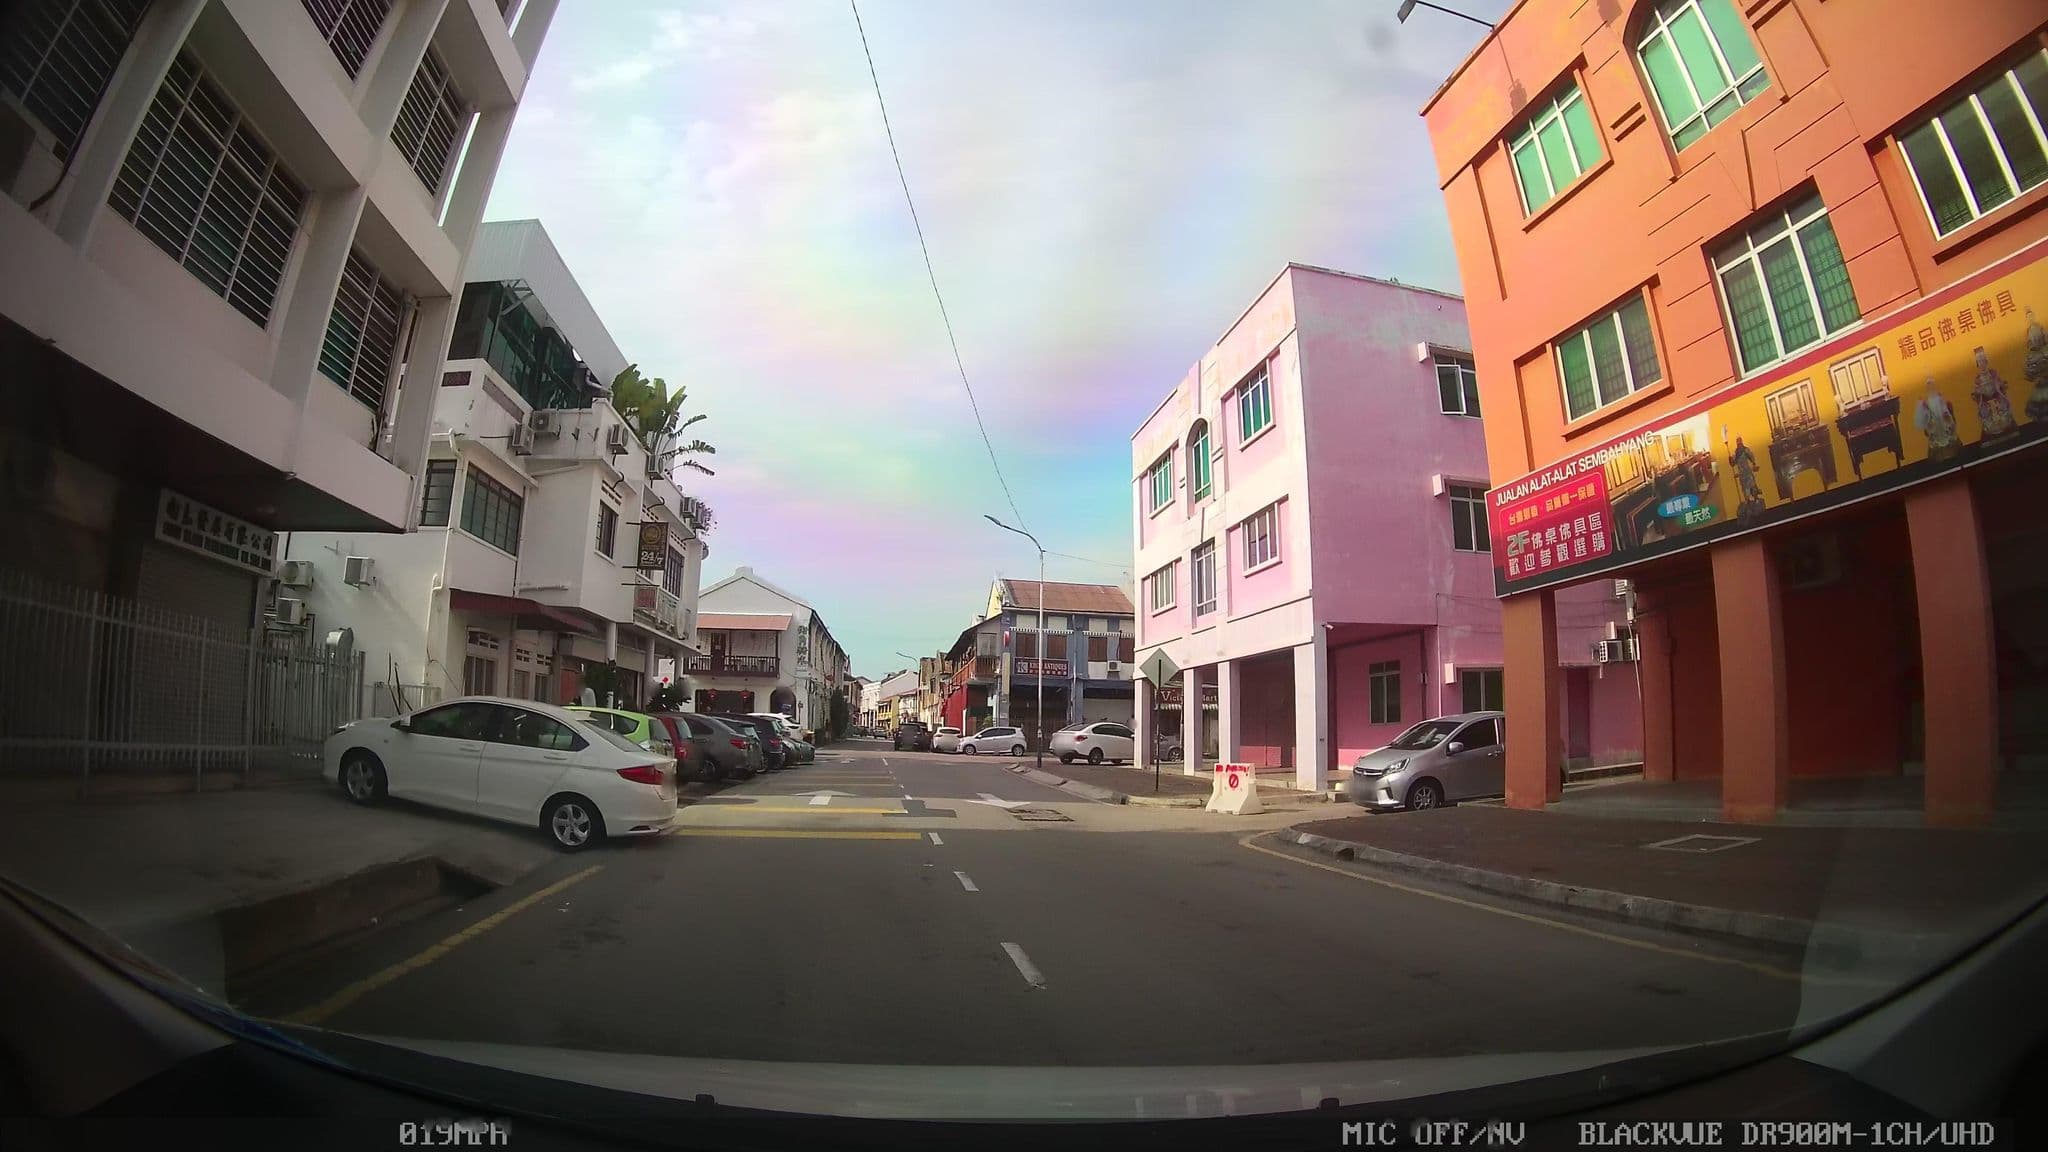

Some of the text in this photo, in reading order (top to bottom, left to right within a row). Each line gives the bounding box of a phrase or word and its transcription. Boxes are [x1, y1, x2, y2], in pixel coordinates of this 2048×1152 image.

[1897, 289, 2017, 360] 精品佛桌佛具
[1496, 430, 1655, 506] JUALAN ALAT-ALAT SEMBAHYANG
[641, 551, 664, 565] 24/7
